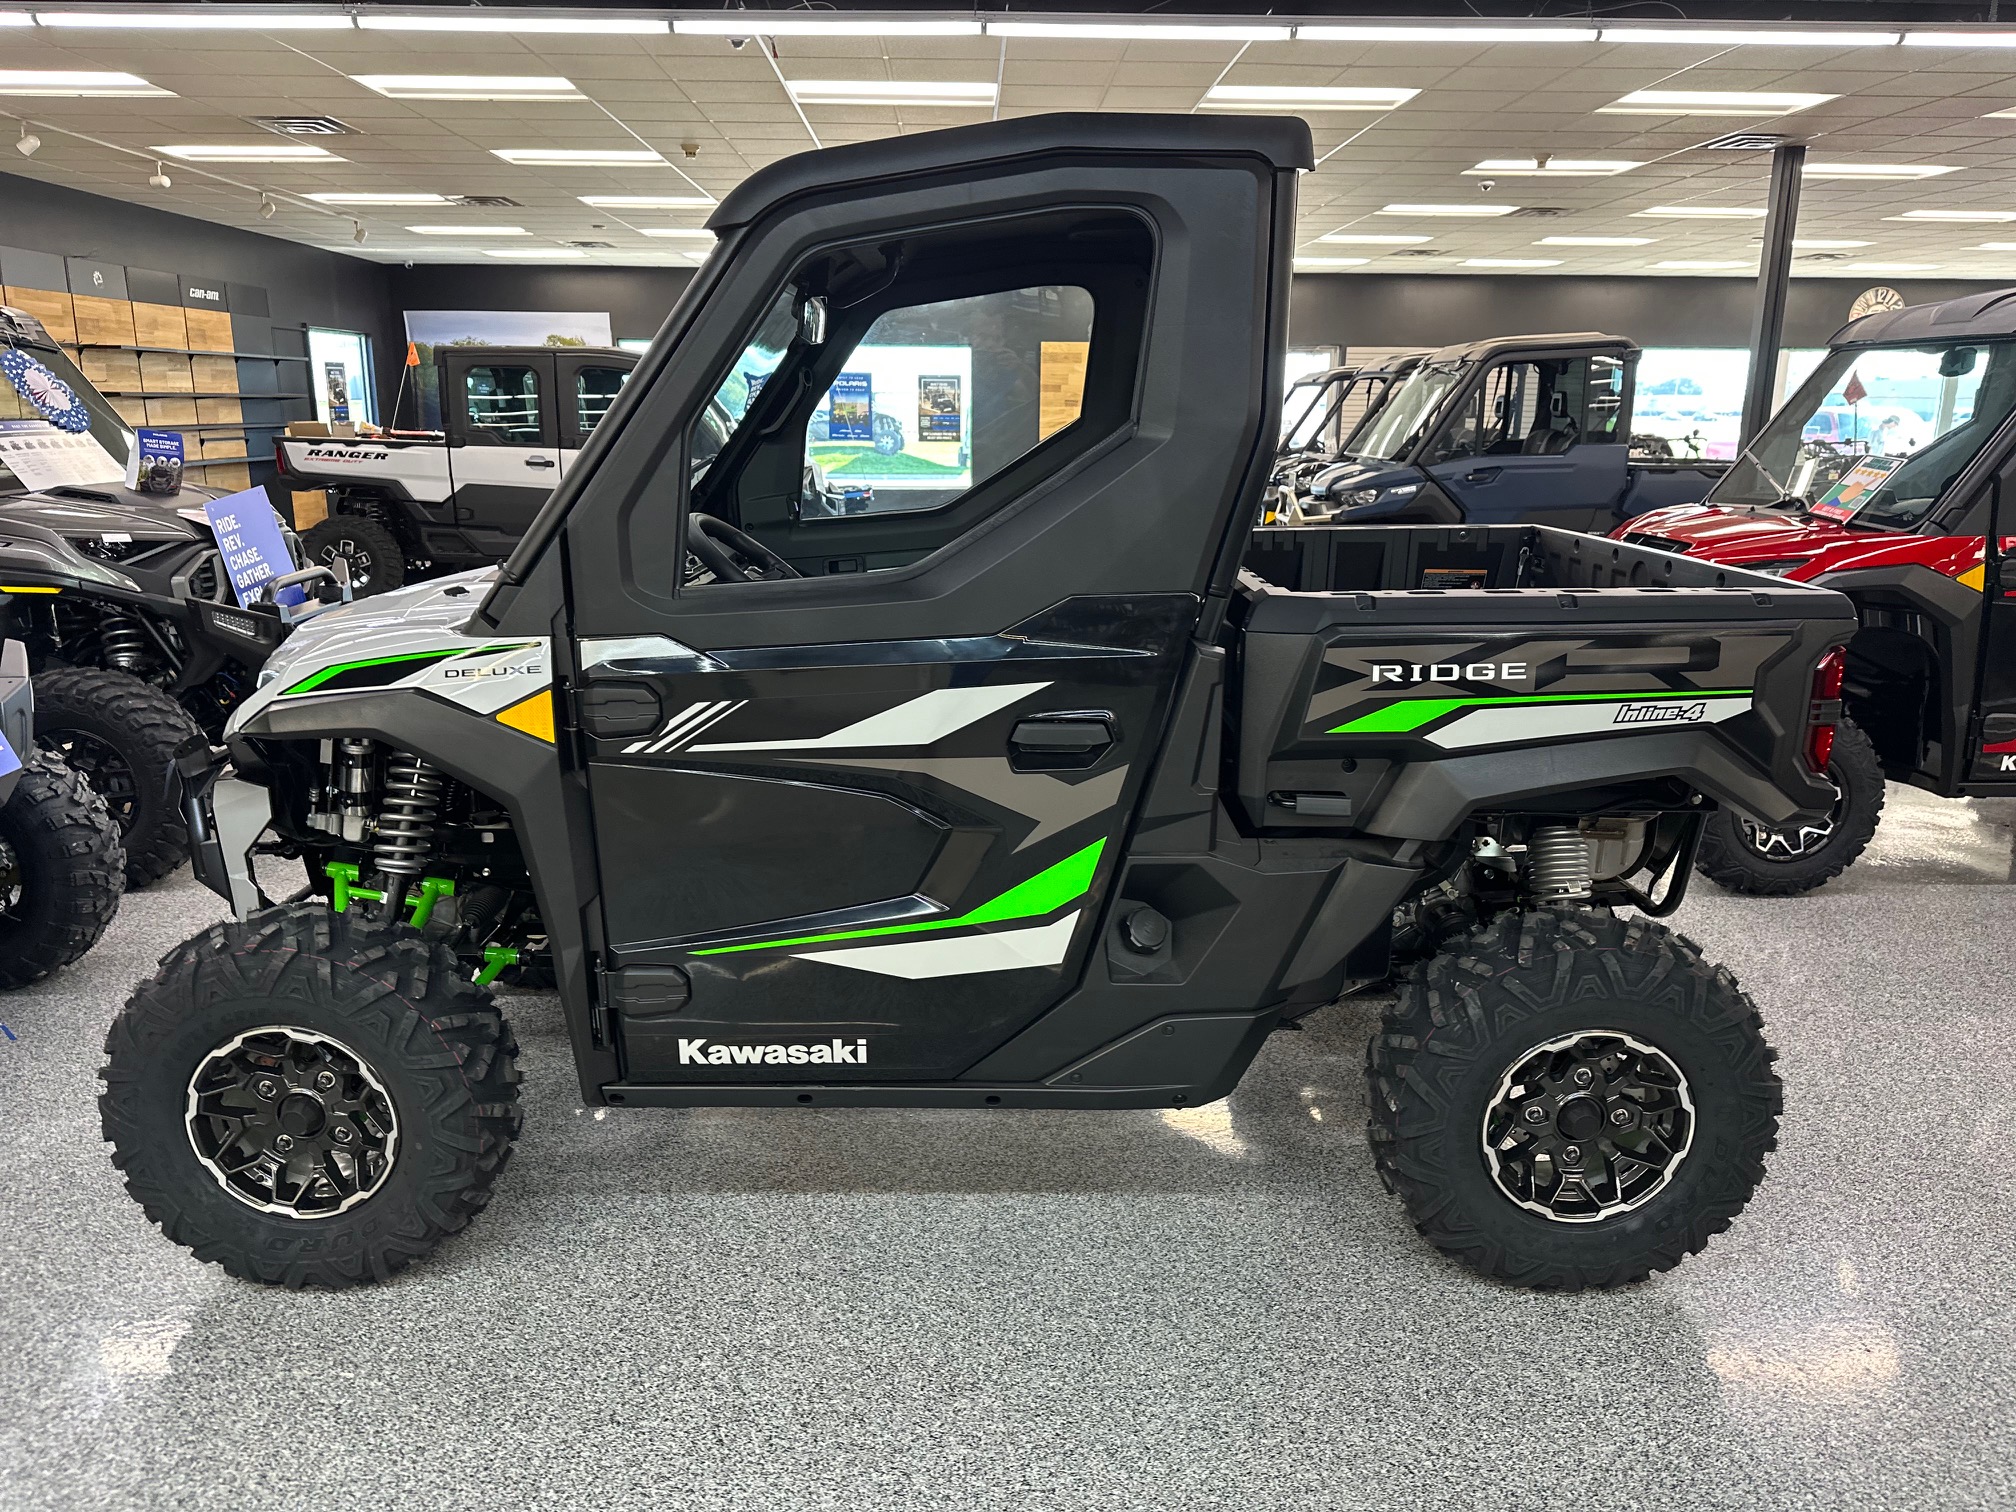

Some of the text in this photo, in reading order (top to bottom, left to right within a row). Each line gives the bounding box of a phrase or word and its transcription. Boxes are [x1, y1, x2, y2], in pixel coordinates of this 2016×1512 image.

[190, 287, 219, 301] can-am
[1877, 288, 1887, 303] 12
[159, 439, 180, 447] STORAGE
[307, 449, 389, 460] RANGER
[215, 514, 241, 534] RIDE.
[222, 533, 245, 552] REV.
[229, 547, 263, 571] CHASE.
[236, 562, 275, 589] GATHER.
[445, 666, 542, 678] DELUXE
[1372, 662, 1527, 682] RIDGE
[1613, 703, 1706, 723] Inline-4
[678, 1038, 868, 1065] Kawasaki
